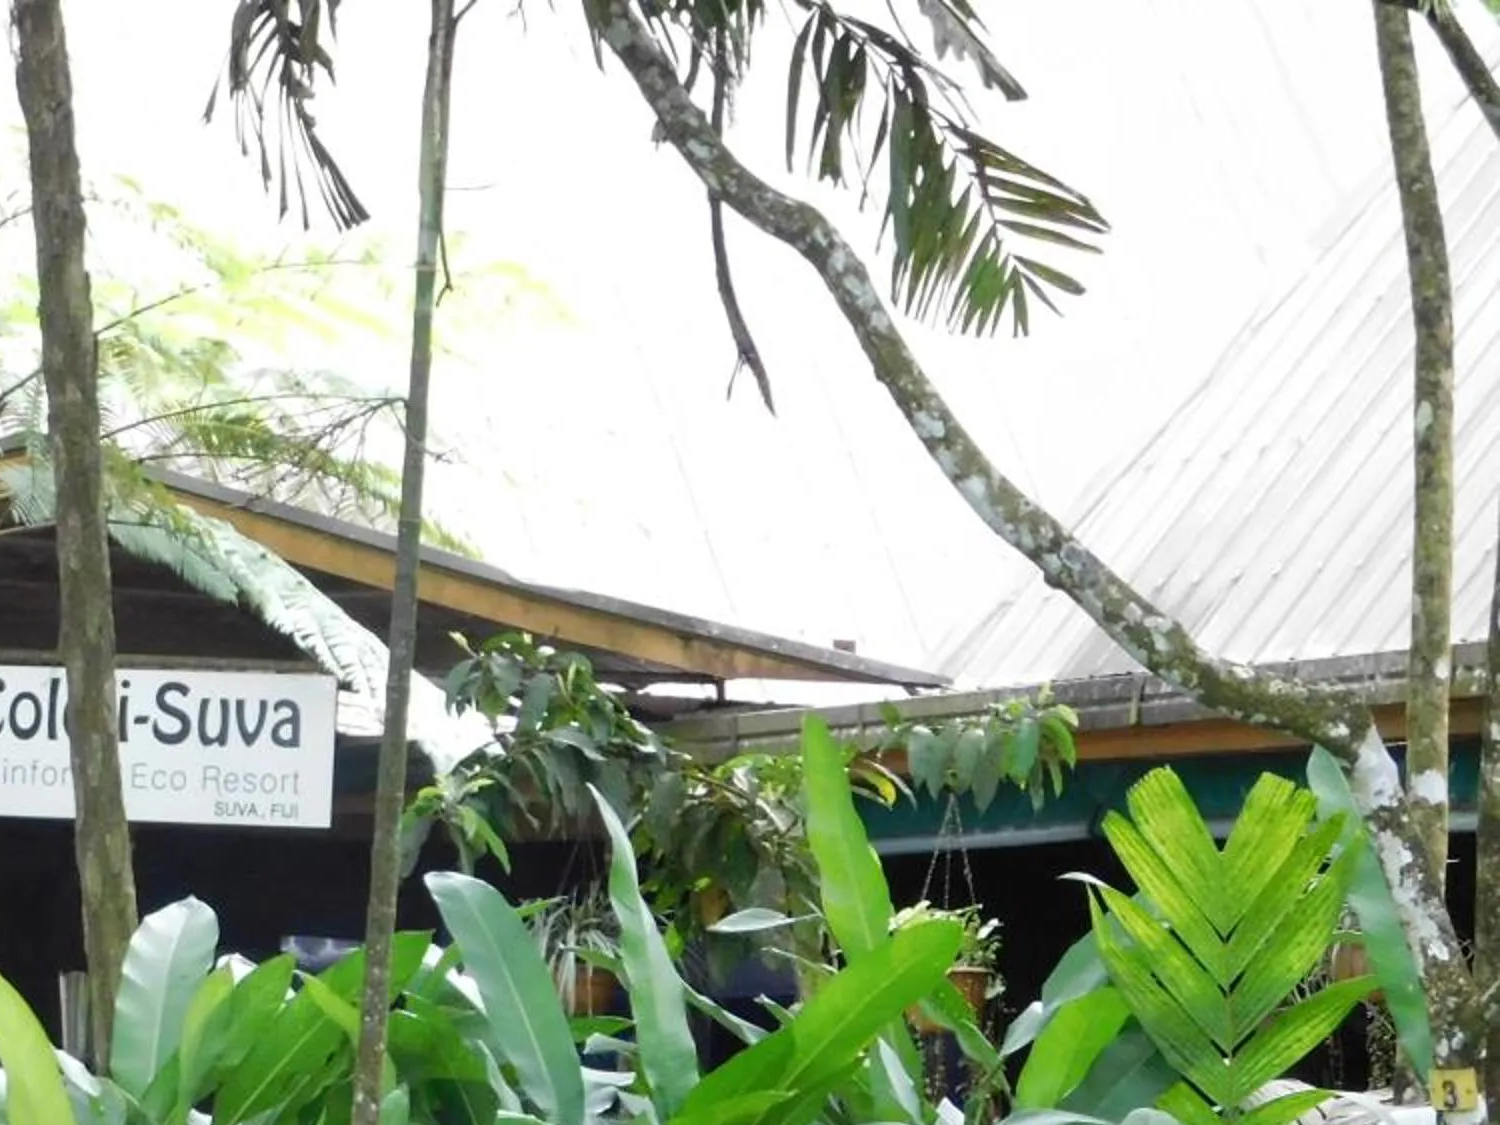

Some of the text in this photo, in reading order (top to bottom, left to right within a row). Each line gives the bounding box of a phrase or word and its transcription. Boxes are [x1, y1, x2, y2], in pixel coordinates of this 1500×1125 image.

[131, 763, 187, 791] Eco
[201, 765, 299, 795] Resort
[270, 803, 299, 819] FIJI
